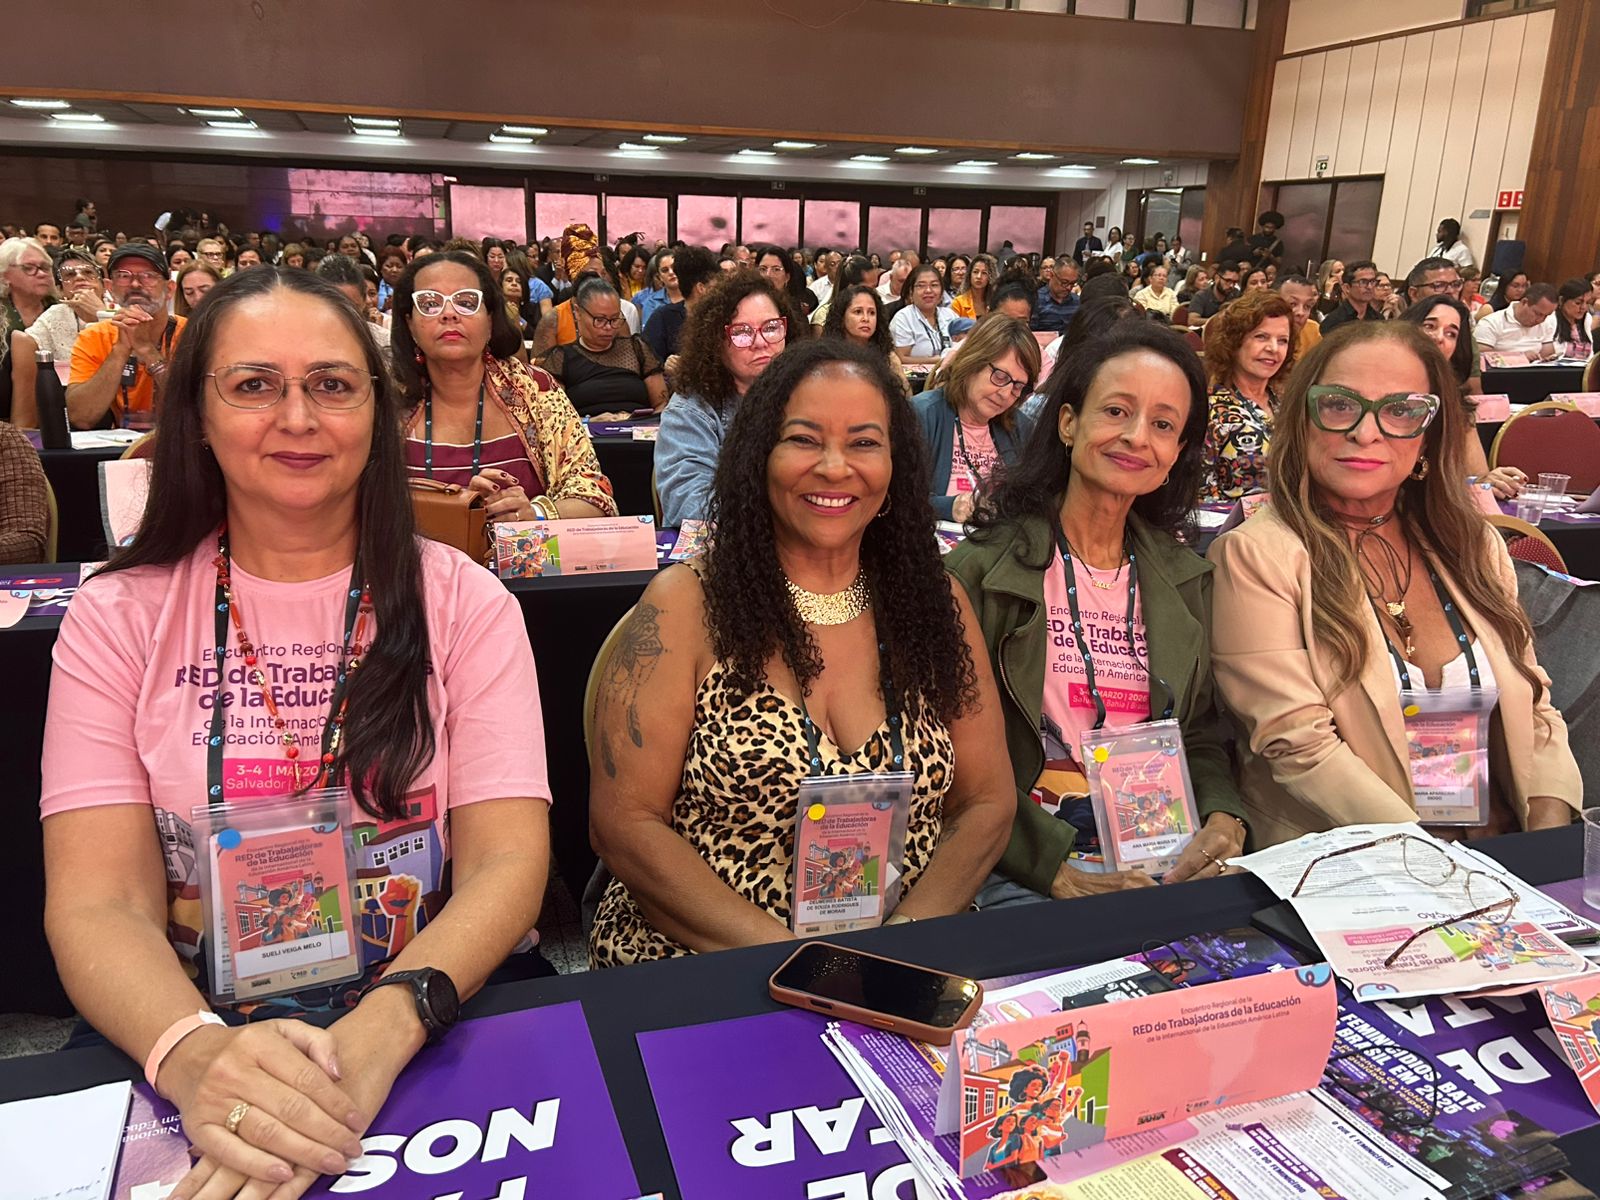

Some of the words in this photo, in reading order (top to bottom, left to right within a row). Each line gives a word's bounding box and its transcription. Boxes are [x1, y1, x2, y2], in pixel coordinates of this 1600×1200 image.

[1054, 634, 1075, 648] de
[1058, 653, 1072, 662] de
[174, 663, 224, 688] RED
[228, 665, 265, 686] de
[1107, 668, 1148, 682] América
[198, 688, 235, 710] de
[240, 686, 265, 708] la
[230, 714, 245, 728] la
[226, 776, 287, 790] Salvador
[235, 853, 254, 863] RED
[255, 851, 267, 861] de
[267, 841, 323, 860] Trabajadoras
[246, 858, 258, 868] de
[268, 849, 314, 864] Educación
[261, 949, 281, 959] SUELI
[282, 946, 302, 956] VEIGA
[303, 941, 322, 951] MELO
[1132, 1025, 1153, 1036] RED
[1154, 1021, 1167, 1032] de
[1168, 1009, 1230, 1030] Trabajadoras
[1231, 1007, 1243, 1017] de
[1244, 1005, 1253, 1014] la
[1254, 996, 1301, 1013] Educación
[1335, 1027, 1393, 1066] BRASIL
[1388, 1064, 1421, 1085] EM
[1340, 1013, 1442, 1082] FEMINICÍDIOS
[1437, 1081, 1487, 1113] BATE
[329, 1097, 561, 1193] NOS
[1337, 1125, 1350, 1135] QUE
[1354, 1138, 1394, 1169] FEMINICÍDIO?
[1248, 1144, 1264, 1157] LEIS
[1261, 1156, 1272, 1165] DO
[1270, 1163, 1307, 1194] FEMINICÍDIO
